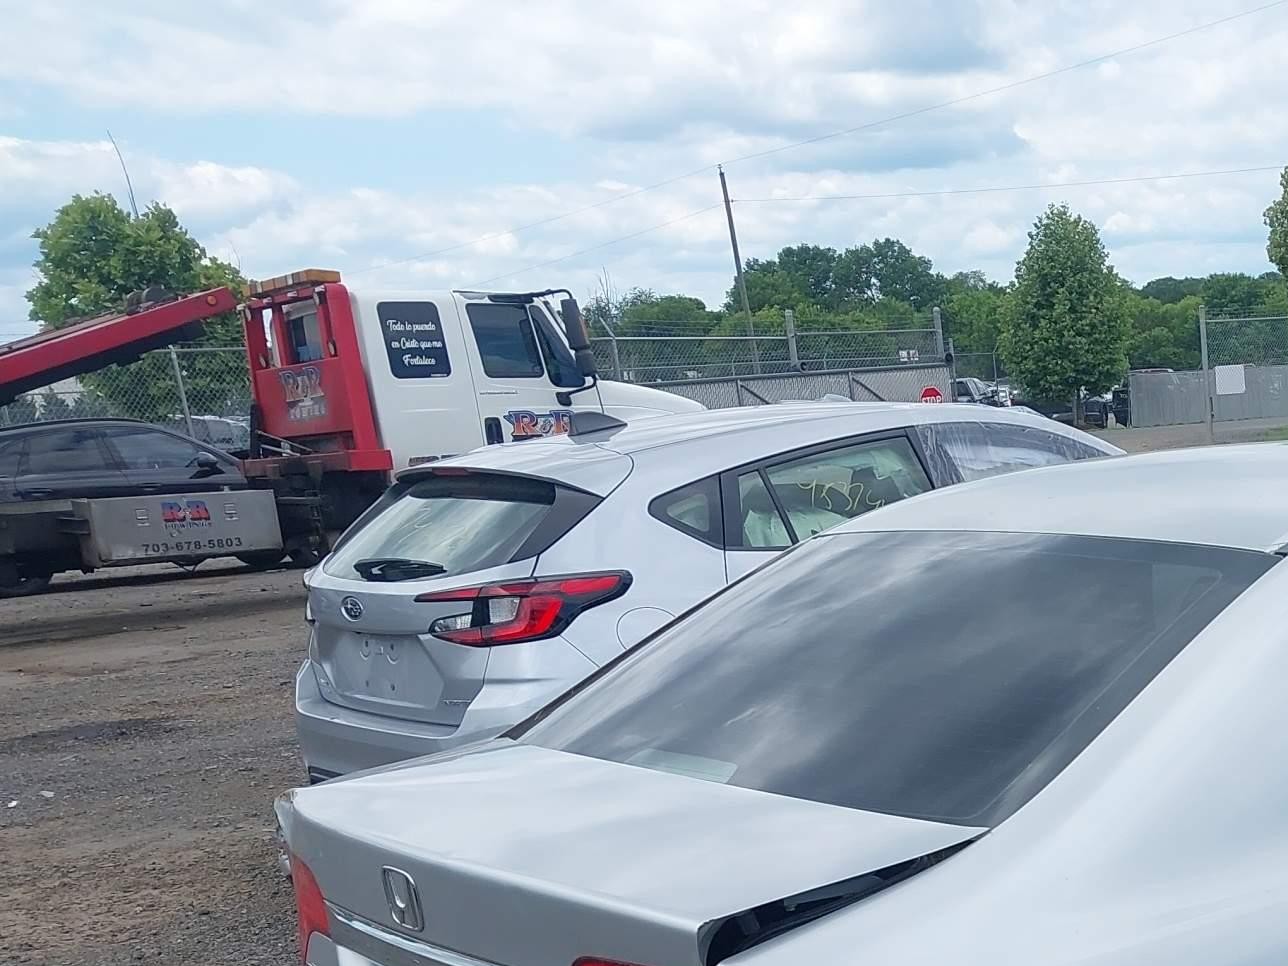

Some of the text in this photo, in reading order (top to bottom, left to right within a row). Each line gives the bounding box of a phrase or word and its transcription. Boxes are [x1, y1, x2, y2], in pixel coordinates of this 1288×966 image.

[387, 320, 405, 331] Todo
[405, 321, 412, 331] lo
[141, 537, 243, 553] 703-678-5803
